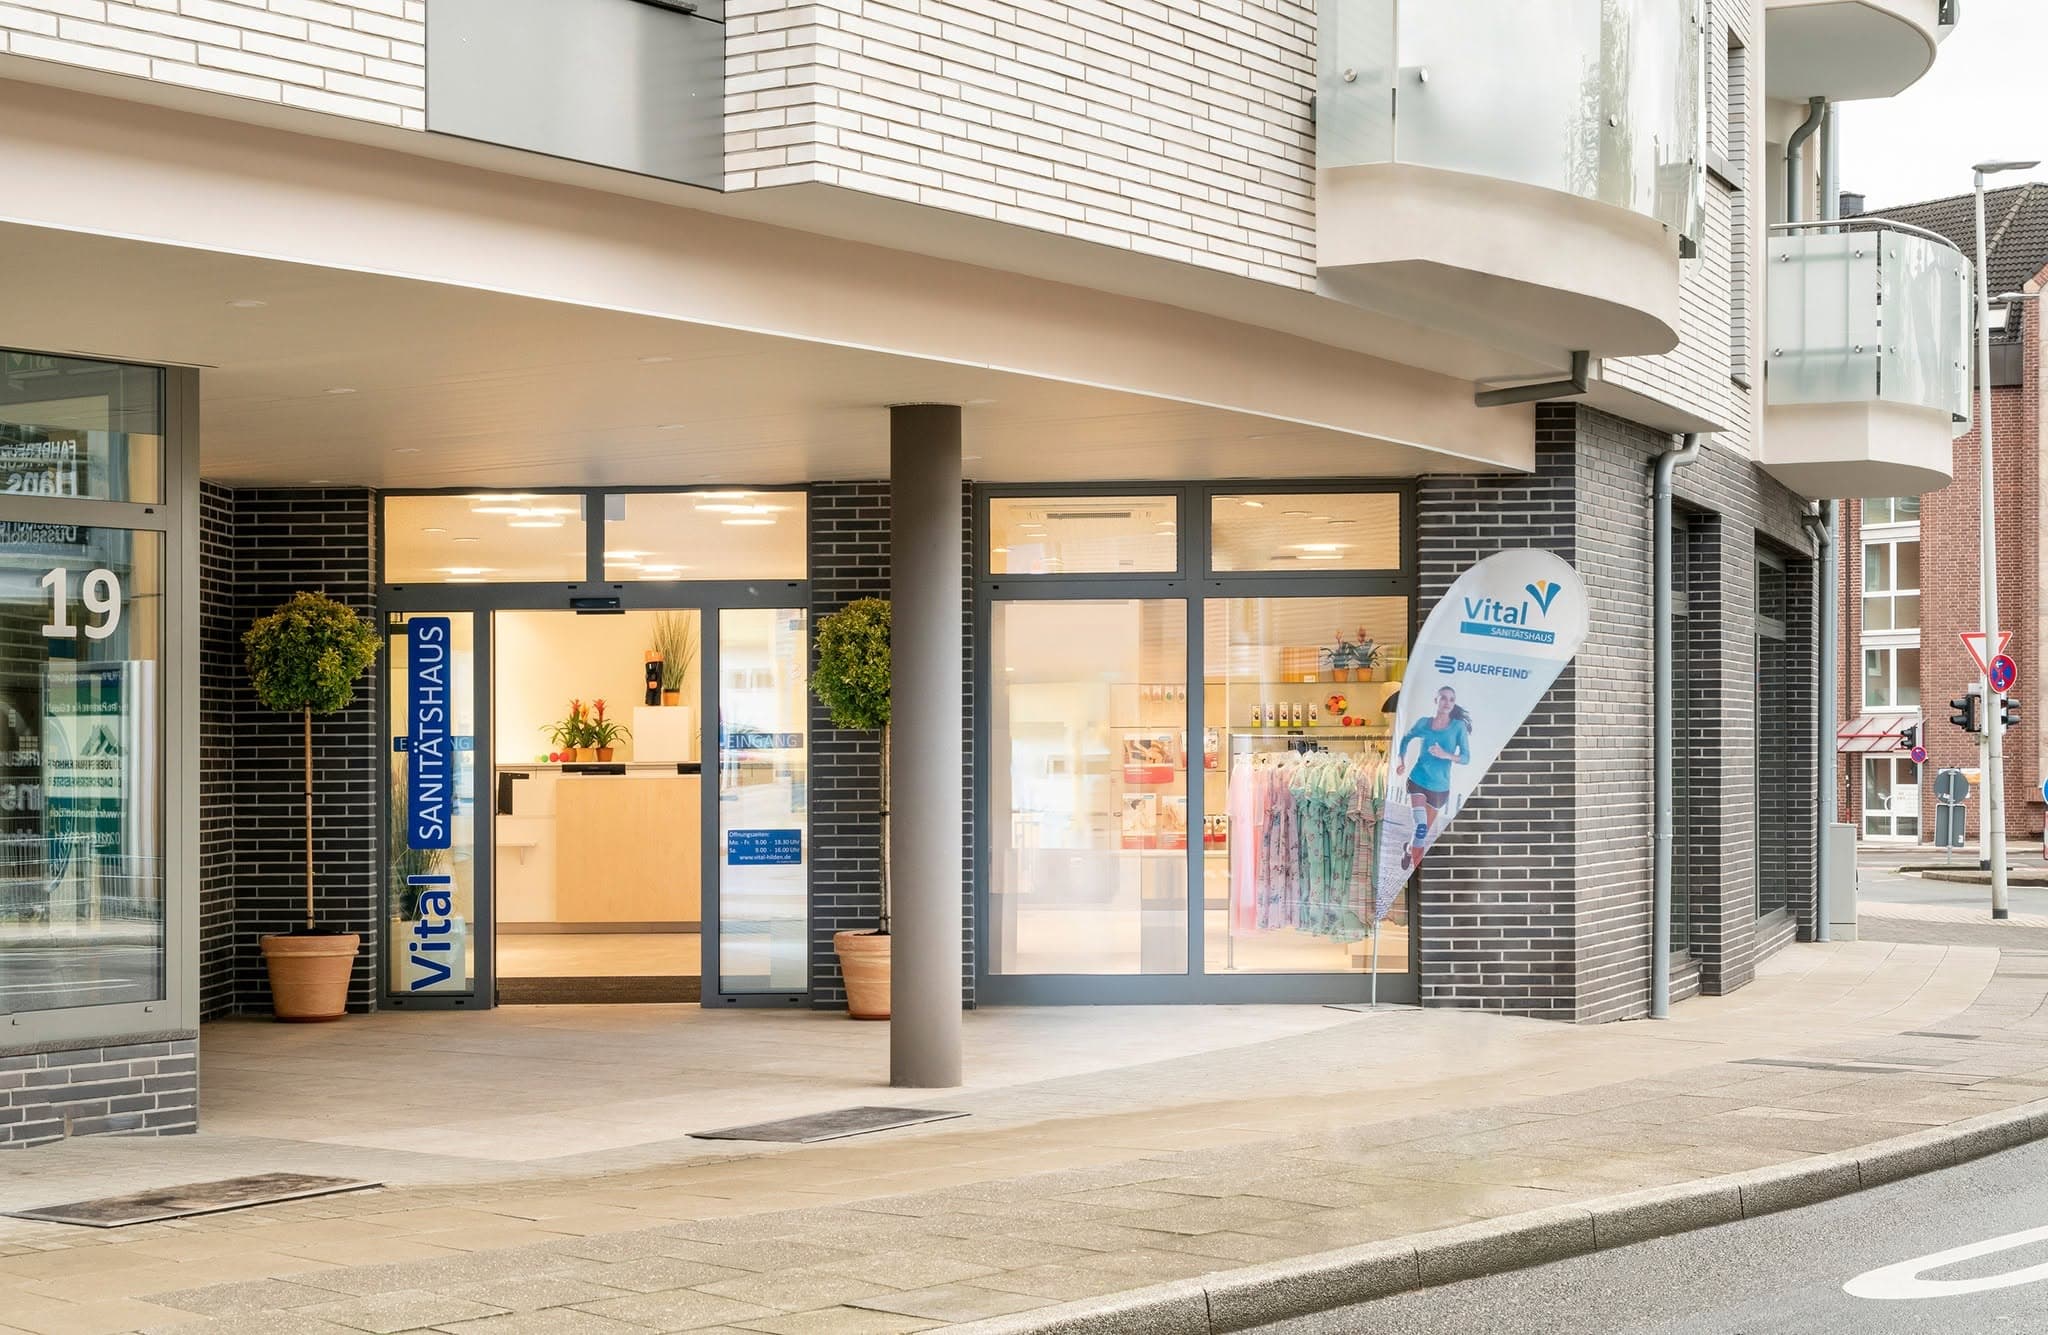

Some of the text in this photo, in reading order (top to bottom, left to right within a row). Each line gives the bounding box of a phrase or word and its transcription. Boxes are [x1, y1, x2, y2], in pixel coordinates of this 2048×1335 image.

[40, 567, 121, 640] 19
[1463, 597, 1529, 625] Vital
[1490, 626, 1553, 643] SANITÄTSHAUS
[413, 625, 443, 840] SANITÄTSHAUS
[728, 734, 798, 748] EINGANG
[408, 874, 451, 992] Vital
